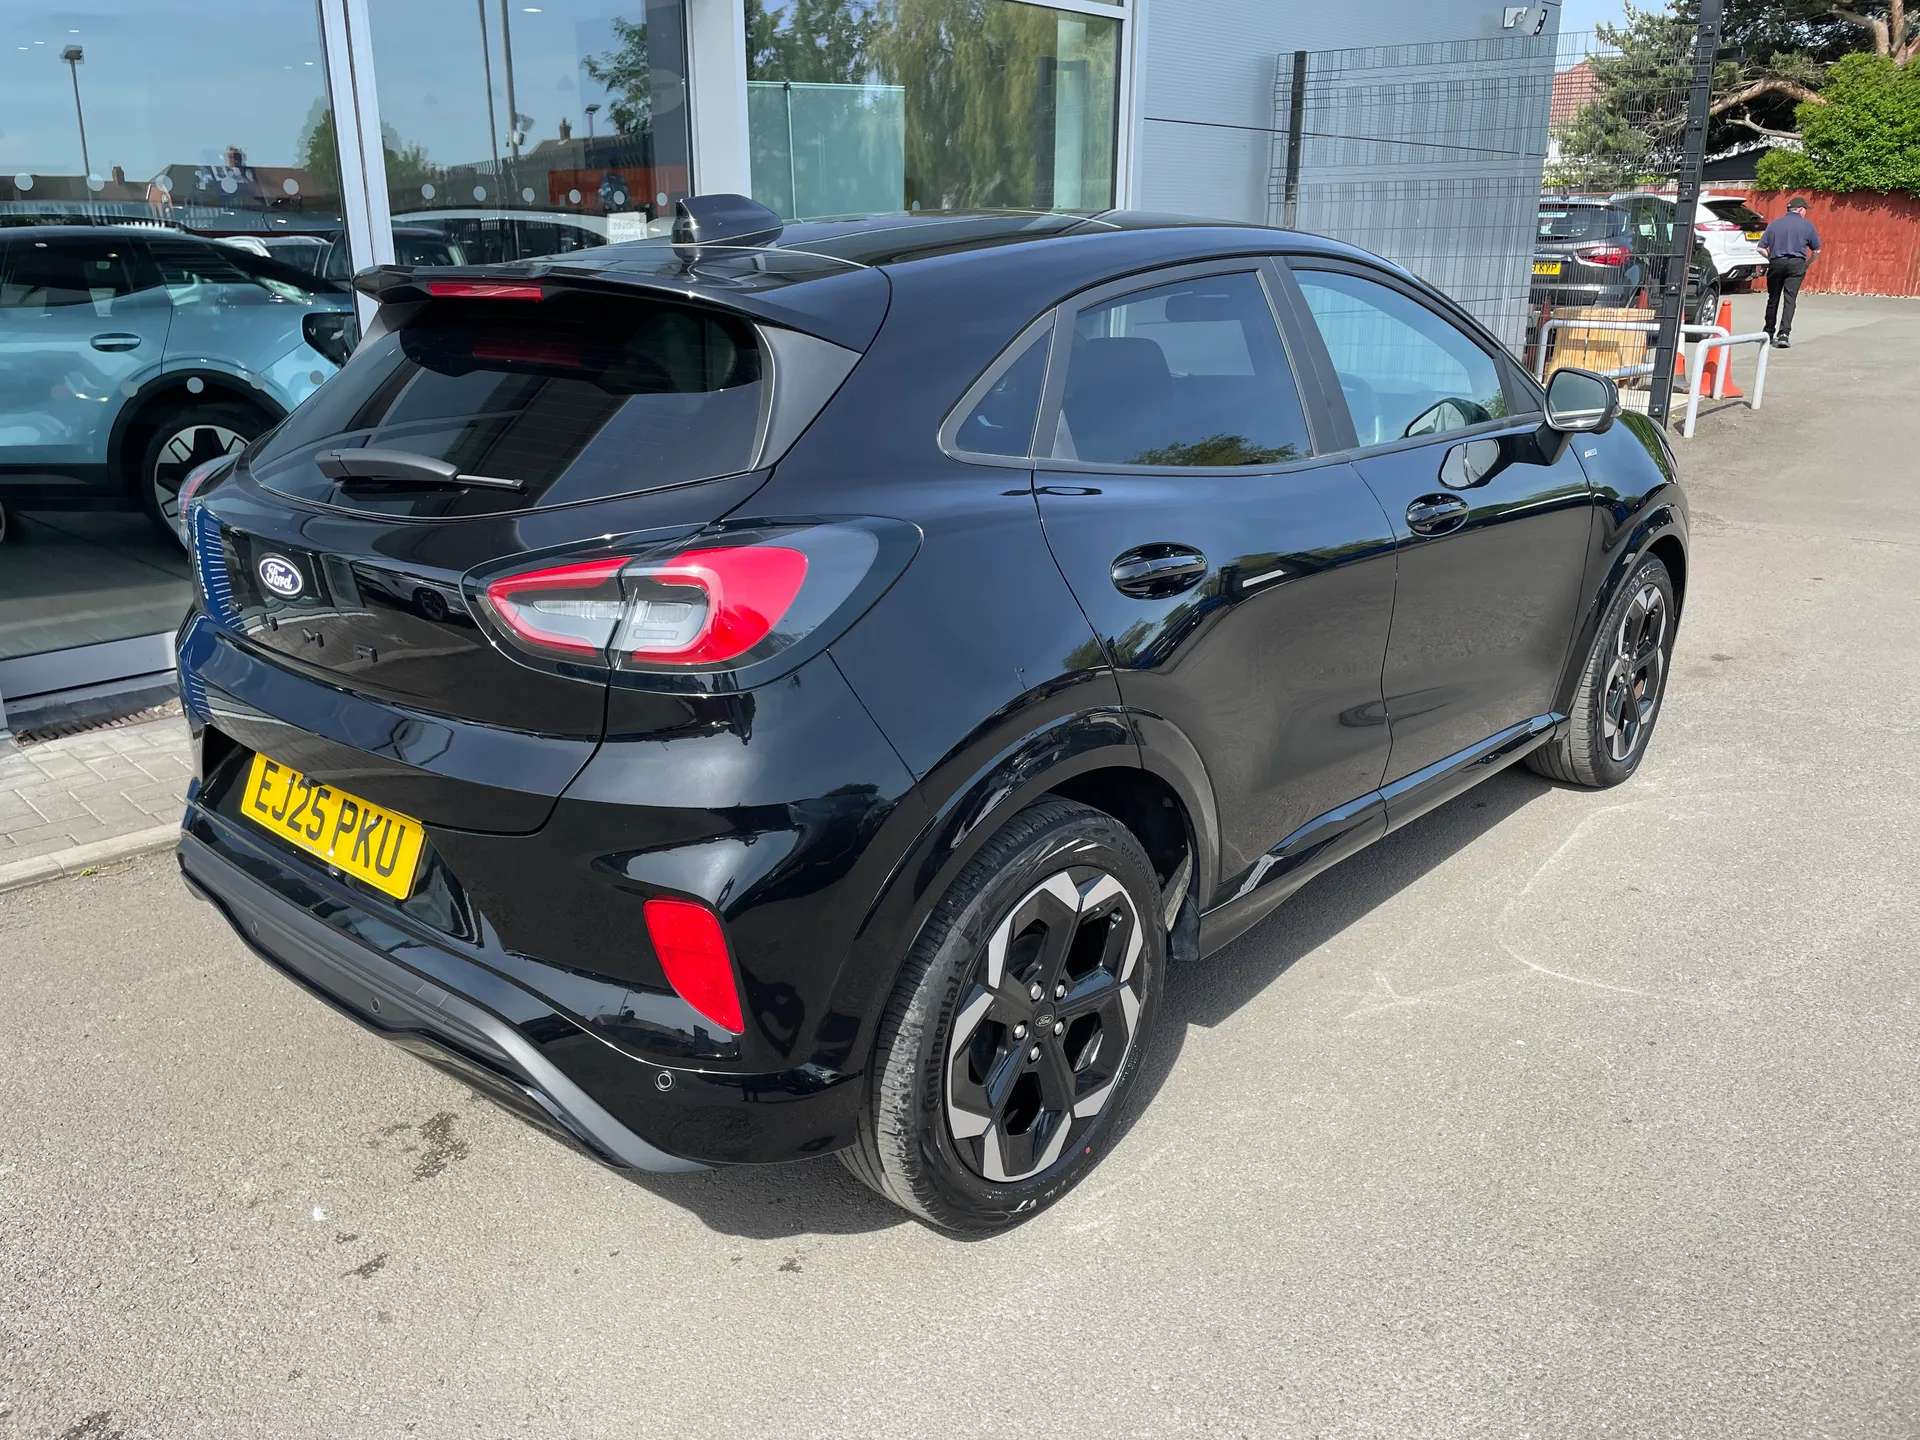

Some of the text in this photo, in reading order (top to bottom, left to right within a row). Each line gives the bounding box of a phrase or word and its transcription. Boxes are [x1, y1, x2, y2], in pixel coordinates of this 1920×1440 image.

[265, 561, 294, 591] Ford
[255, 759, 406, 878] EJ25 PKU
